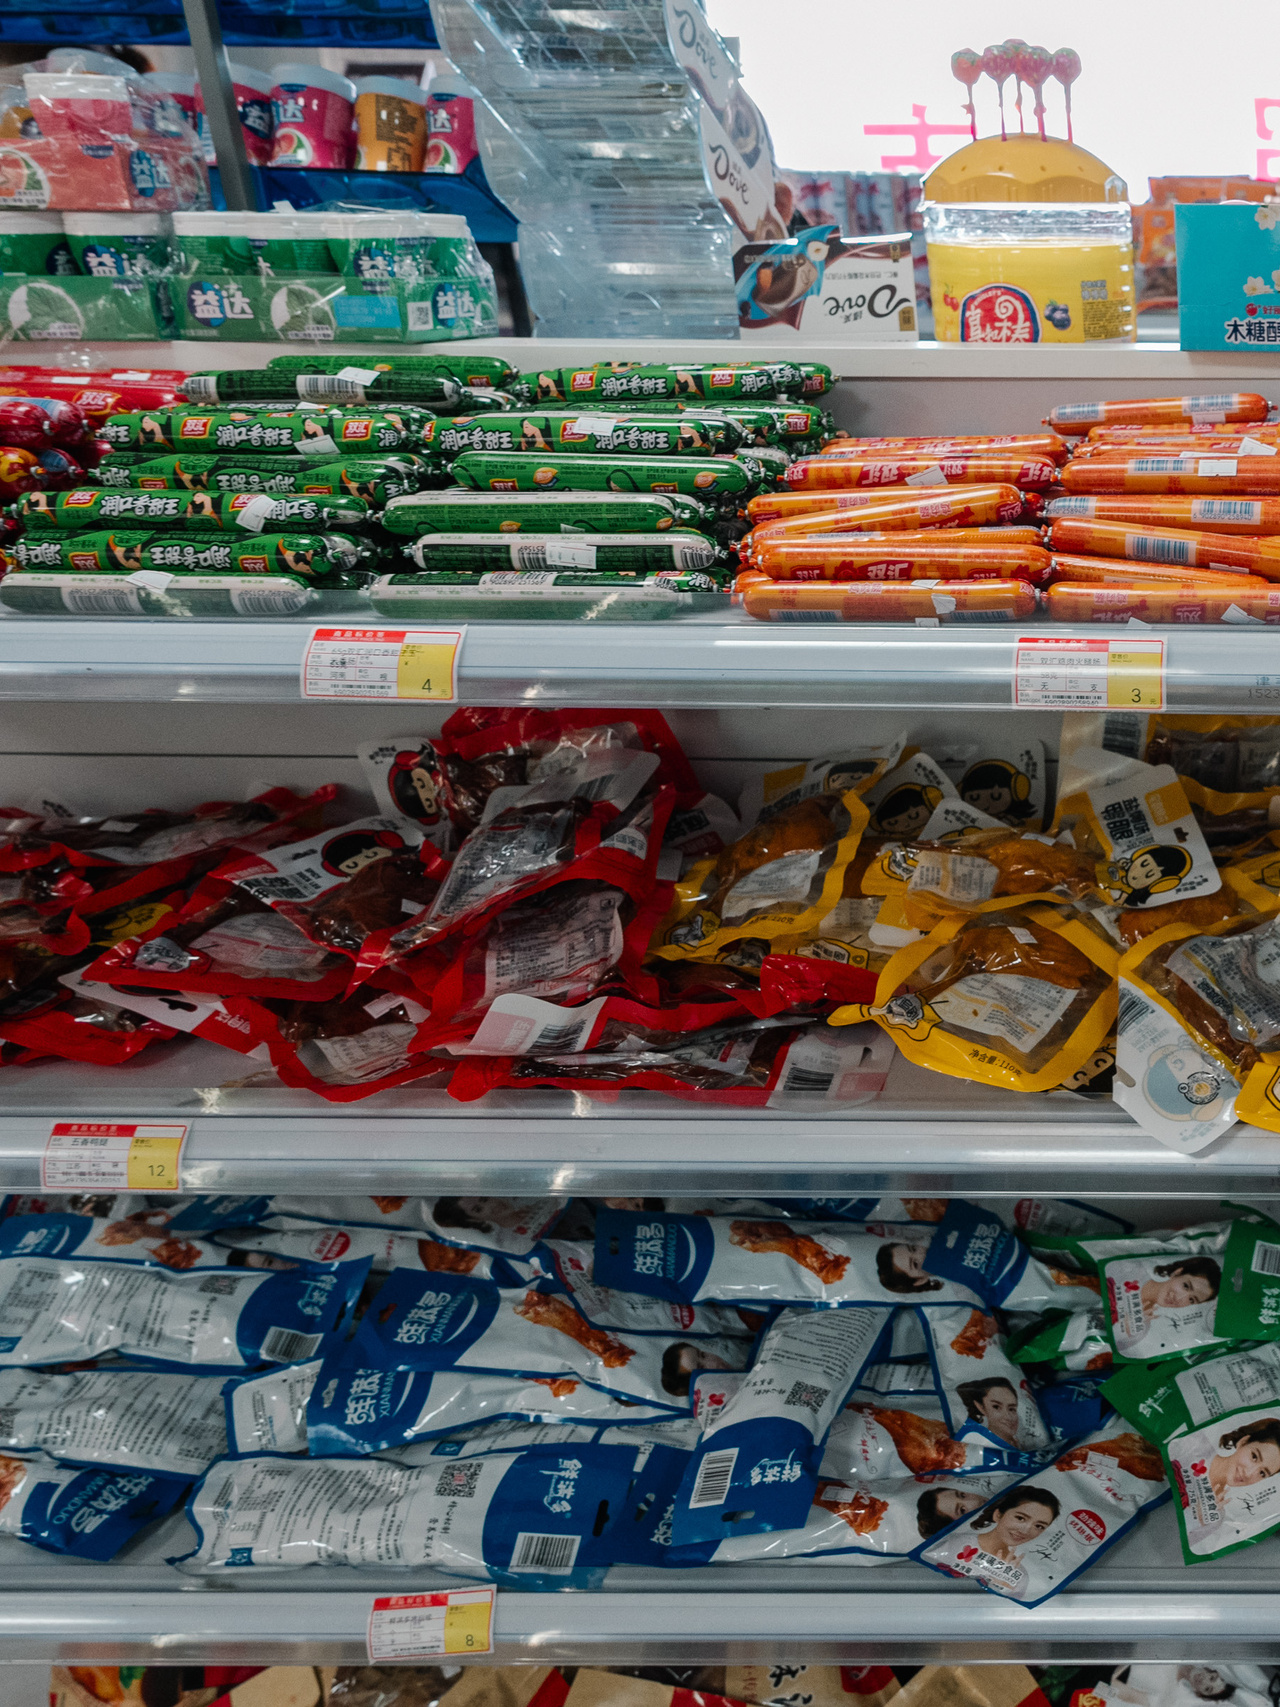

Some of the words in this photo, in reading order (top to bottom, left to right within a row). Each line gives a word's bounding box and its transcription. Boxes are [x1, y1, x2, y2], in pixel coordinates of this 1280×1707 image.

[191, 283, 255, 320] 益达
[823, 284, 911, 319] Dove
[601, 376, 668, 397] 润口香甜王
[183, 418, 212, 435] 双汇
[216, 424, 293, 448] 润口香甜王
[439, 428, 514, 452] 润口香甜王
[596, 428, 669, 450] 润口香甜王
[100, 494, 180, 516] 润口香甜王
[867, 561, 909, 580] 双汇
[421, 678, 432, 694] 4
[1131, 688, 1142, 703] 3
[1121, 795, 1150, 840] 盐焗味
[147, 1164, 166, 1177] 12
[633, 1222, 665, 1277] 鲜满多
[393, 1290, 452, 1345] 鲜满多
[344, 1368, 384, 1426] 鲜满
[749, 1448, 803, 1487] 鲜满多
[541, 1458, 584, 1514] 鲜满多
[1199, 1476, 1220, 1523] 鲜满多食品
[976, 1551, 1023, 1581] 鲜满多食品
[465, 1634, 475, 1647] 8
